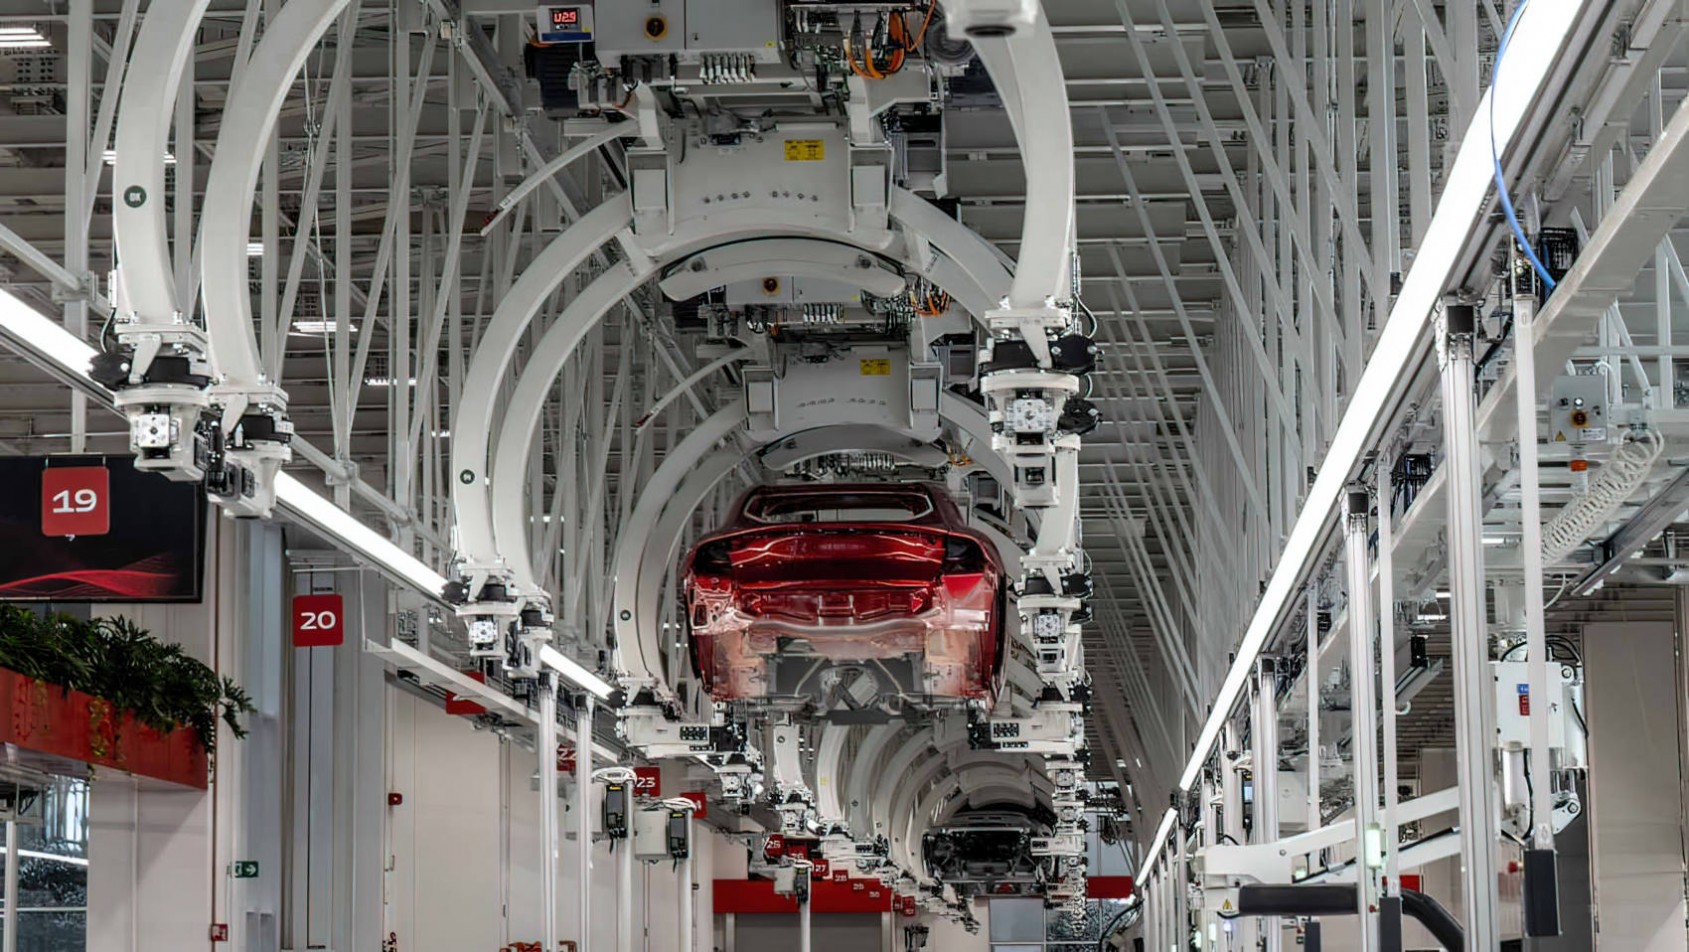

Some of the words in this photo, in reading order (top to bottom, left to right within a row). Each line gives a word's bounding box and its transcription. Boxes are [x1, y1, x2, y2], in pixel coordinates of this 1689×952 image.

[52, 488, 97, 513] 19
[300, 611, 336, 630] 20
[637, 777, 656, 788] 23
[815, 864, 827, 873] 27
